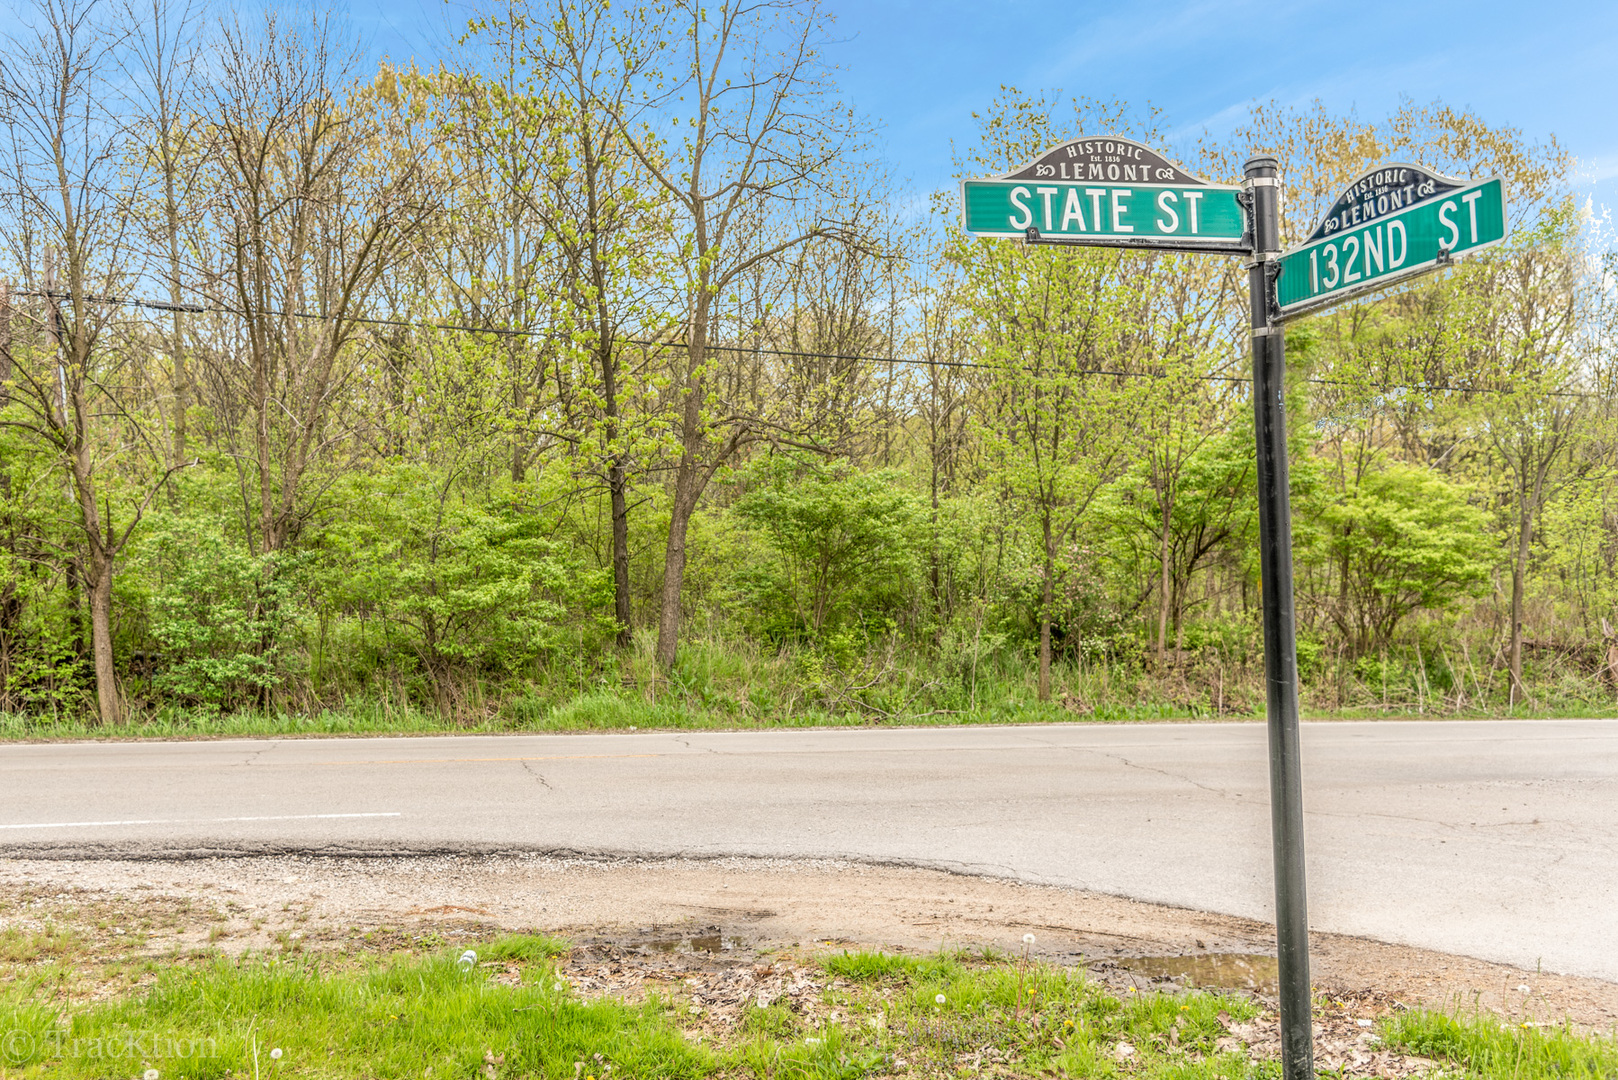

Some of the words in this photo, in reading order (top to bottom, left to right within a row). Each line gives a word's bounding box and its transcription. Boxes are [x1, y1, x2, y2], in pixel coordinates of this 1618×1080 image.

[1066, 142, 1143, 161] HISTORIC
[1060, 163, 1152, 182] LEMONT
[1346, 169, 1407, 204] HISTORIC
[1009, 187, 1134, 233] STATE
[1157, 191, 1203, 234] ST
[1341, 184, 1415, 230] LEMONT
[1310, 219, 1407, 293] 132ND
[1438, 189, 1482, 250] ST
